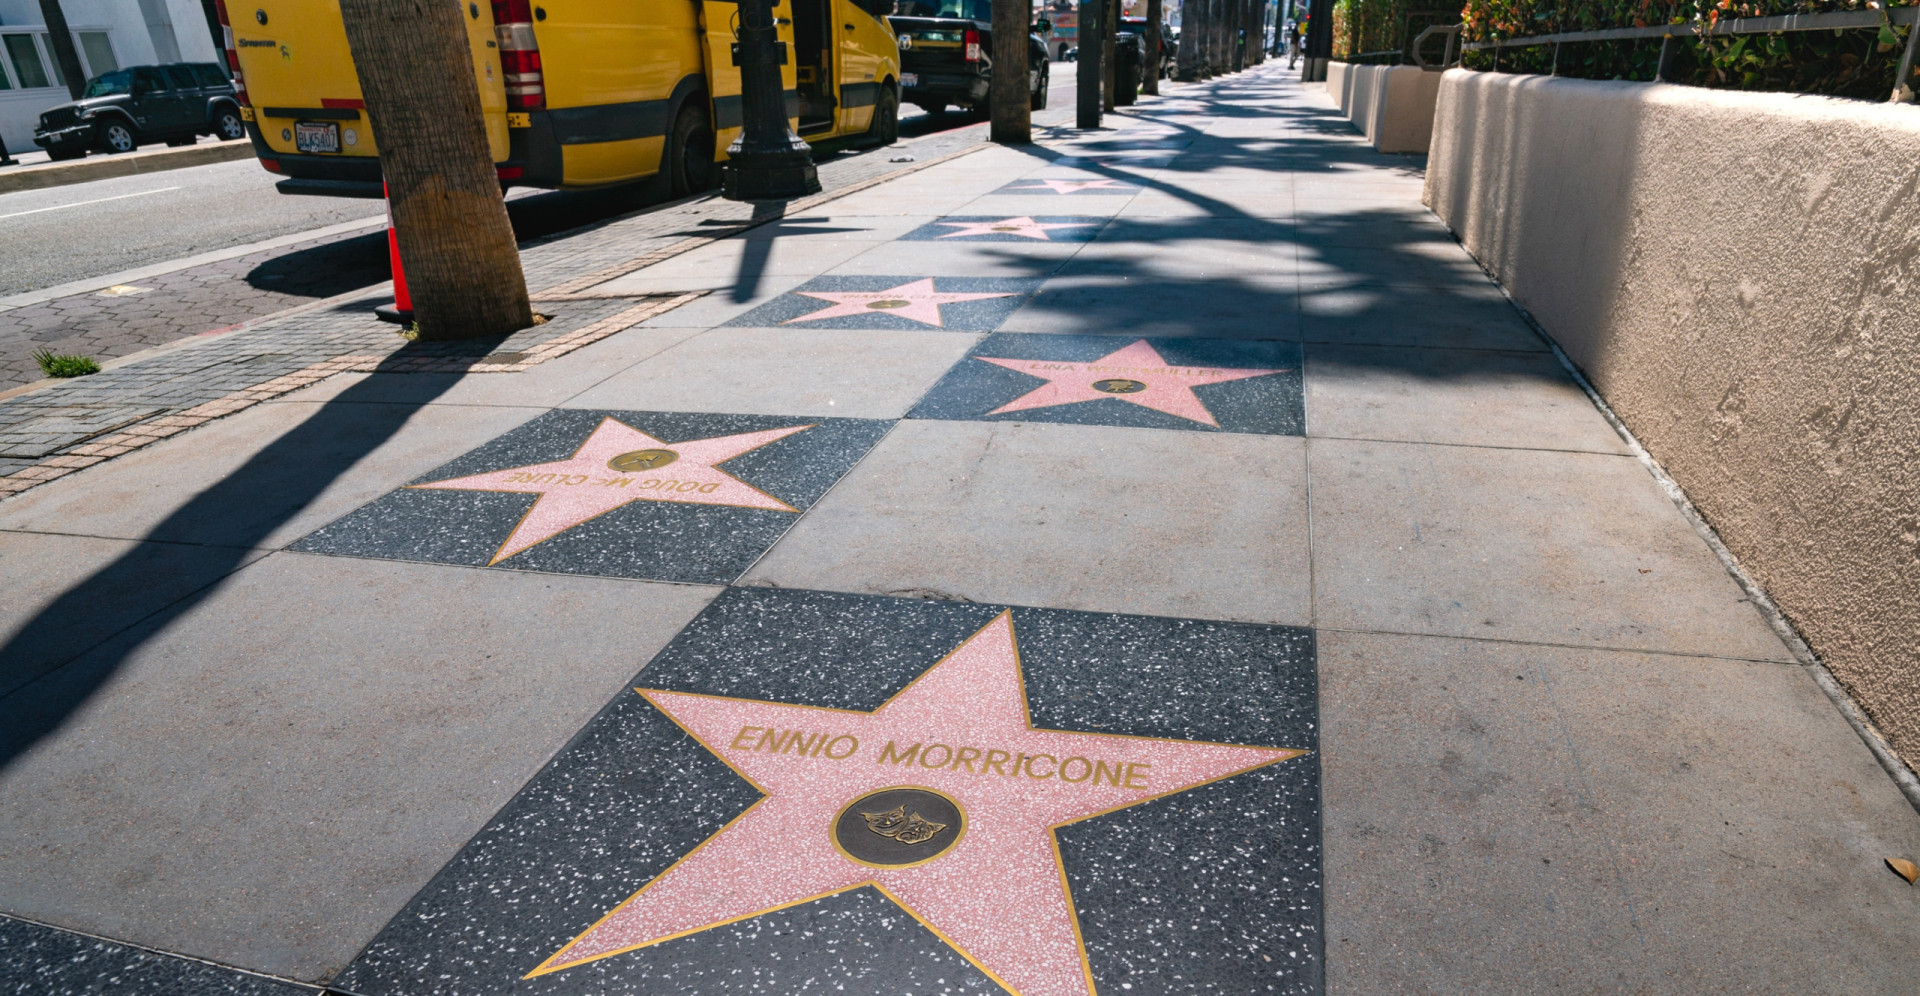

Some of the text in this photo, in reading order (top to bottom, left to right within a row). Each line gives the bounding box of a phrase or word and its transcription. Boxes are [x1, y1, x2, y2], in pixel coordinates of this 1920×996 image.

[1030, 363, 1075, 371] LINA
[504, 471, 588, 486] CLURE
[639, 479, 721, 493] DOUG
[729, 725, 1152, 790] ENNIO MORRICONE
